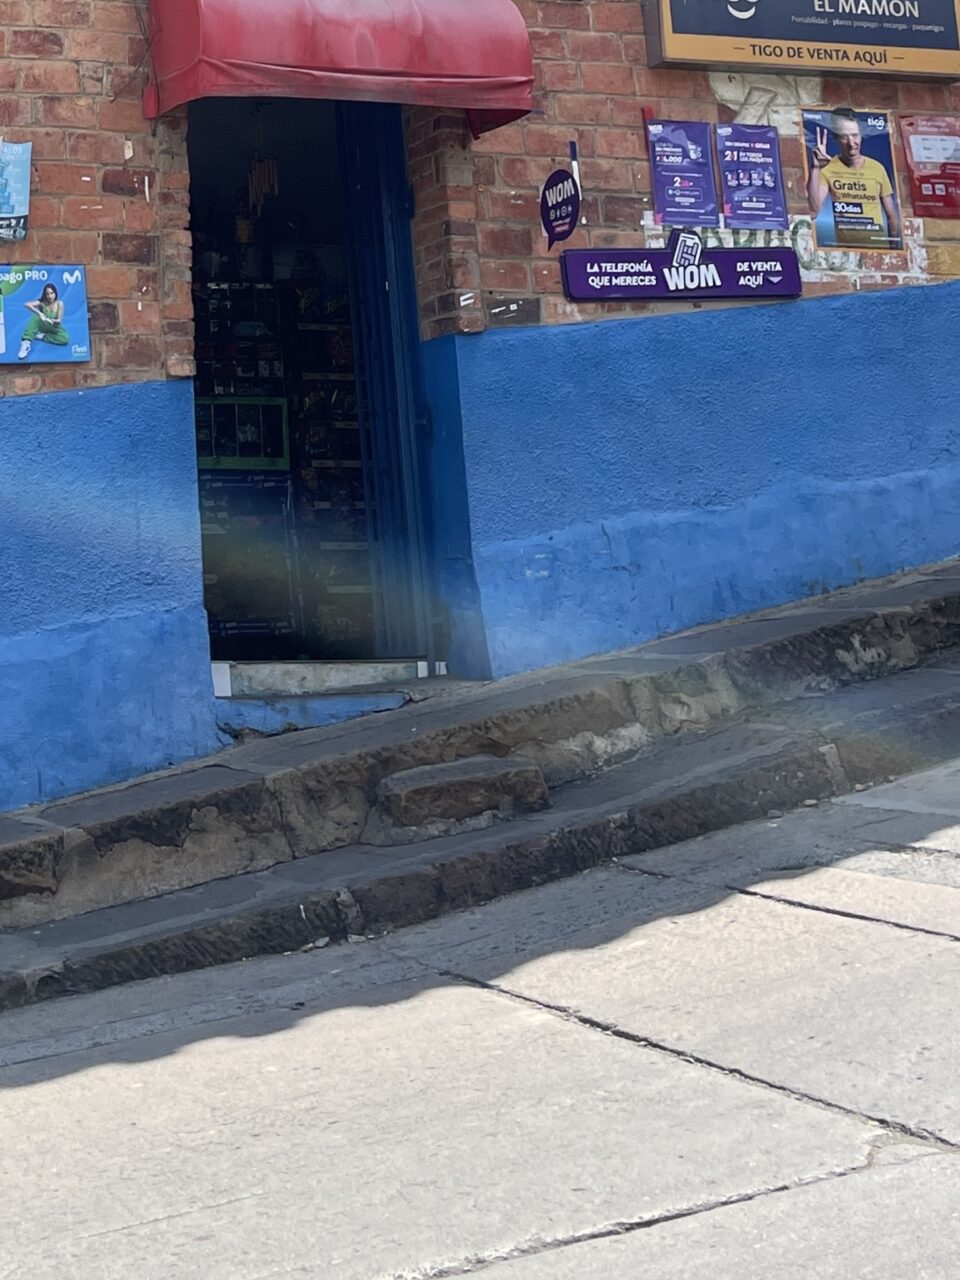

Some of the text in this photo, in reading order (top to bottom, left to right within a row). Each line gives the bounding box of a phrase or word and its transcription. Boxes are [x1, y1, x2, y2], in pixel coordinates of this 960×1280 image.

[750, 43, 888, 65] TIGO DE VENTA AQUÍ
[833, 179, 867, 191] Gratis
[546, 178, 575, 207] WOM
[842, 193, 876, 202] WhatsApp
[587, 259, 652, 272] LA TELEFONÍA
[737, 261, 782, 271] DE VENTA
[25, 271, 48, 281] PRO
[589, 275, 656, 288] QUE MERECES
[663, 263, 722, 291] WOM
[739, 273, 763, 288] AQUÍ
